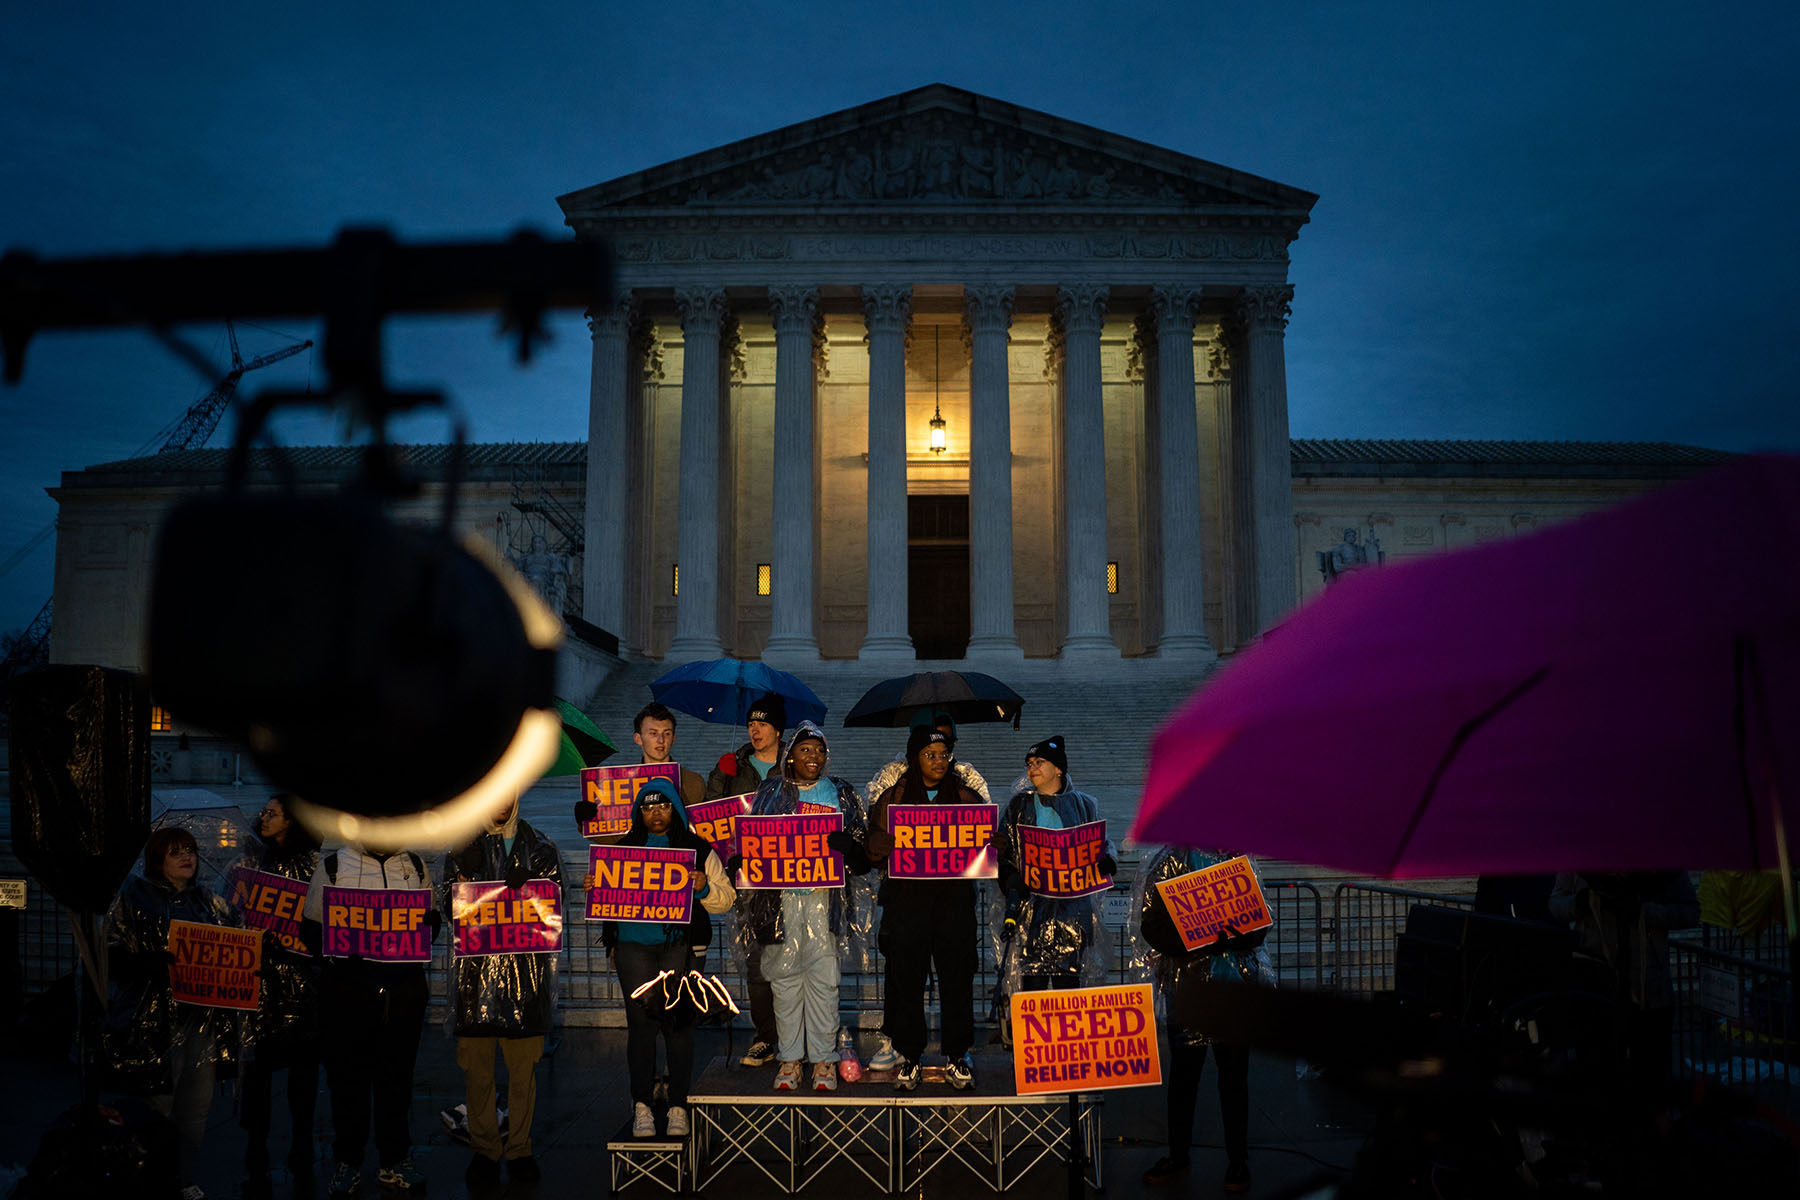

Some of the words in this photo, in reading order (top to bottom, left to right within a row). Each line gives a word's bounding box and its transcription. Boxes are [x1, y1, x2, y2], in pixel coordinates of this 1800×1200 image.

[806, 239, 873, 255] EQUAL
[878, 239, 952, 255] JUSTICE
[961, 239, 1026, 255] UNDER
[1033, 239, 1071, 255] LAW
[638, 765, 675, 777] FAMILIES
[692, 801, 744, 822] STUDENT
[895, 809, 953, 825] STUDENT
[957, 809, 992, 825] LOAN
[742, 820, 799, 835] STUDENT
[803, 819, 837, 834] LOAN
[894, 824, 993, 849] RELIEF
[1023, 829, 1071, 848] STUDENT
[1074, 827, 1101, 845] LOAN
[595, 847, 608, 859] 40
[610, 847, 646, 861] MILLION
[649, 850, 690, 863] FAMILIES
[895, 849, 917, 873] IS
[1024, 839, 1103, 870] RELIEF
[593, 858, 690, 892] NEED
[742, 858, 764, 883] IS
[771, 857, 840, 883] LEGAL
[1024, 864, 1042, 890] IS
[1047, 862, 1108, 893] LEGAL
[1164, 885, 1176, 895] 40
[1175, 873, 1209, 892] MILLION
[1209, 862, 1246, 883] FAMILIES
[328, 891, 386, 908] STUDENT
[389, 893, 426, 908] LOAN
[592, 888, 649, 906] STUDENT
[652, 890, 687, 906] LOAN
[1168, 873, 1252, 916] NEED
[328, 904, 427, 932] RELIEF
[590, 903, 642, 919] RELIEF
[642, 905, 686, 920] NOW
[1178, 904, 1228, 929] STUDENT
[1229, 893, 1260, 915] LOAN
[175, 926, 188, 938] 40
[190, 926, 220, 942] MILLION
[222, 931, 257, 947] FAMILIES
[327, 928, 351, 953] IS
[358, 931, 427, 957] LEGAL
[459, 926, 481, 952] IS
[1185, 920, 1226, 942] RELIEF
[174, 937, 256, 970] NEED
[224, 968, 256, 987] LOAN
[217, 984, 255, 1001] NOW
[1020, 999, 1036, 1013] 40
[1040, 996, 1088, 1012] MILLION
[1091, 991, 1144, 1008] FAMILIES
[1020, 1006, 1146, 1044] NEED
[1023, 1041, 1099, 1065] STUDENT
[1105, 1037, 1149, 1059] LOAN
[1024, 1062, 1091, 1084] RELIEF
[1095, 1057, 1151, 1078] NOW
